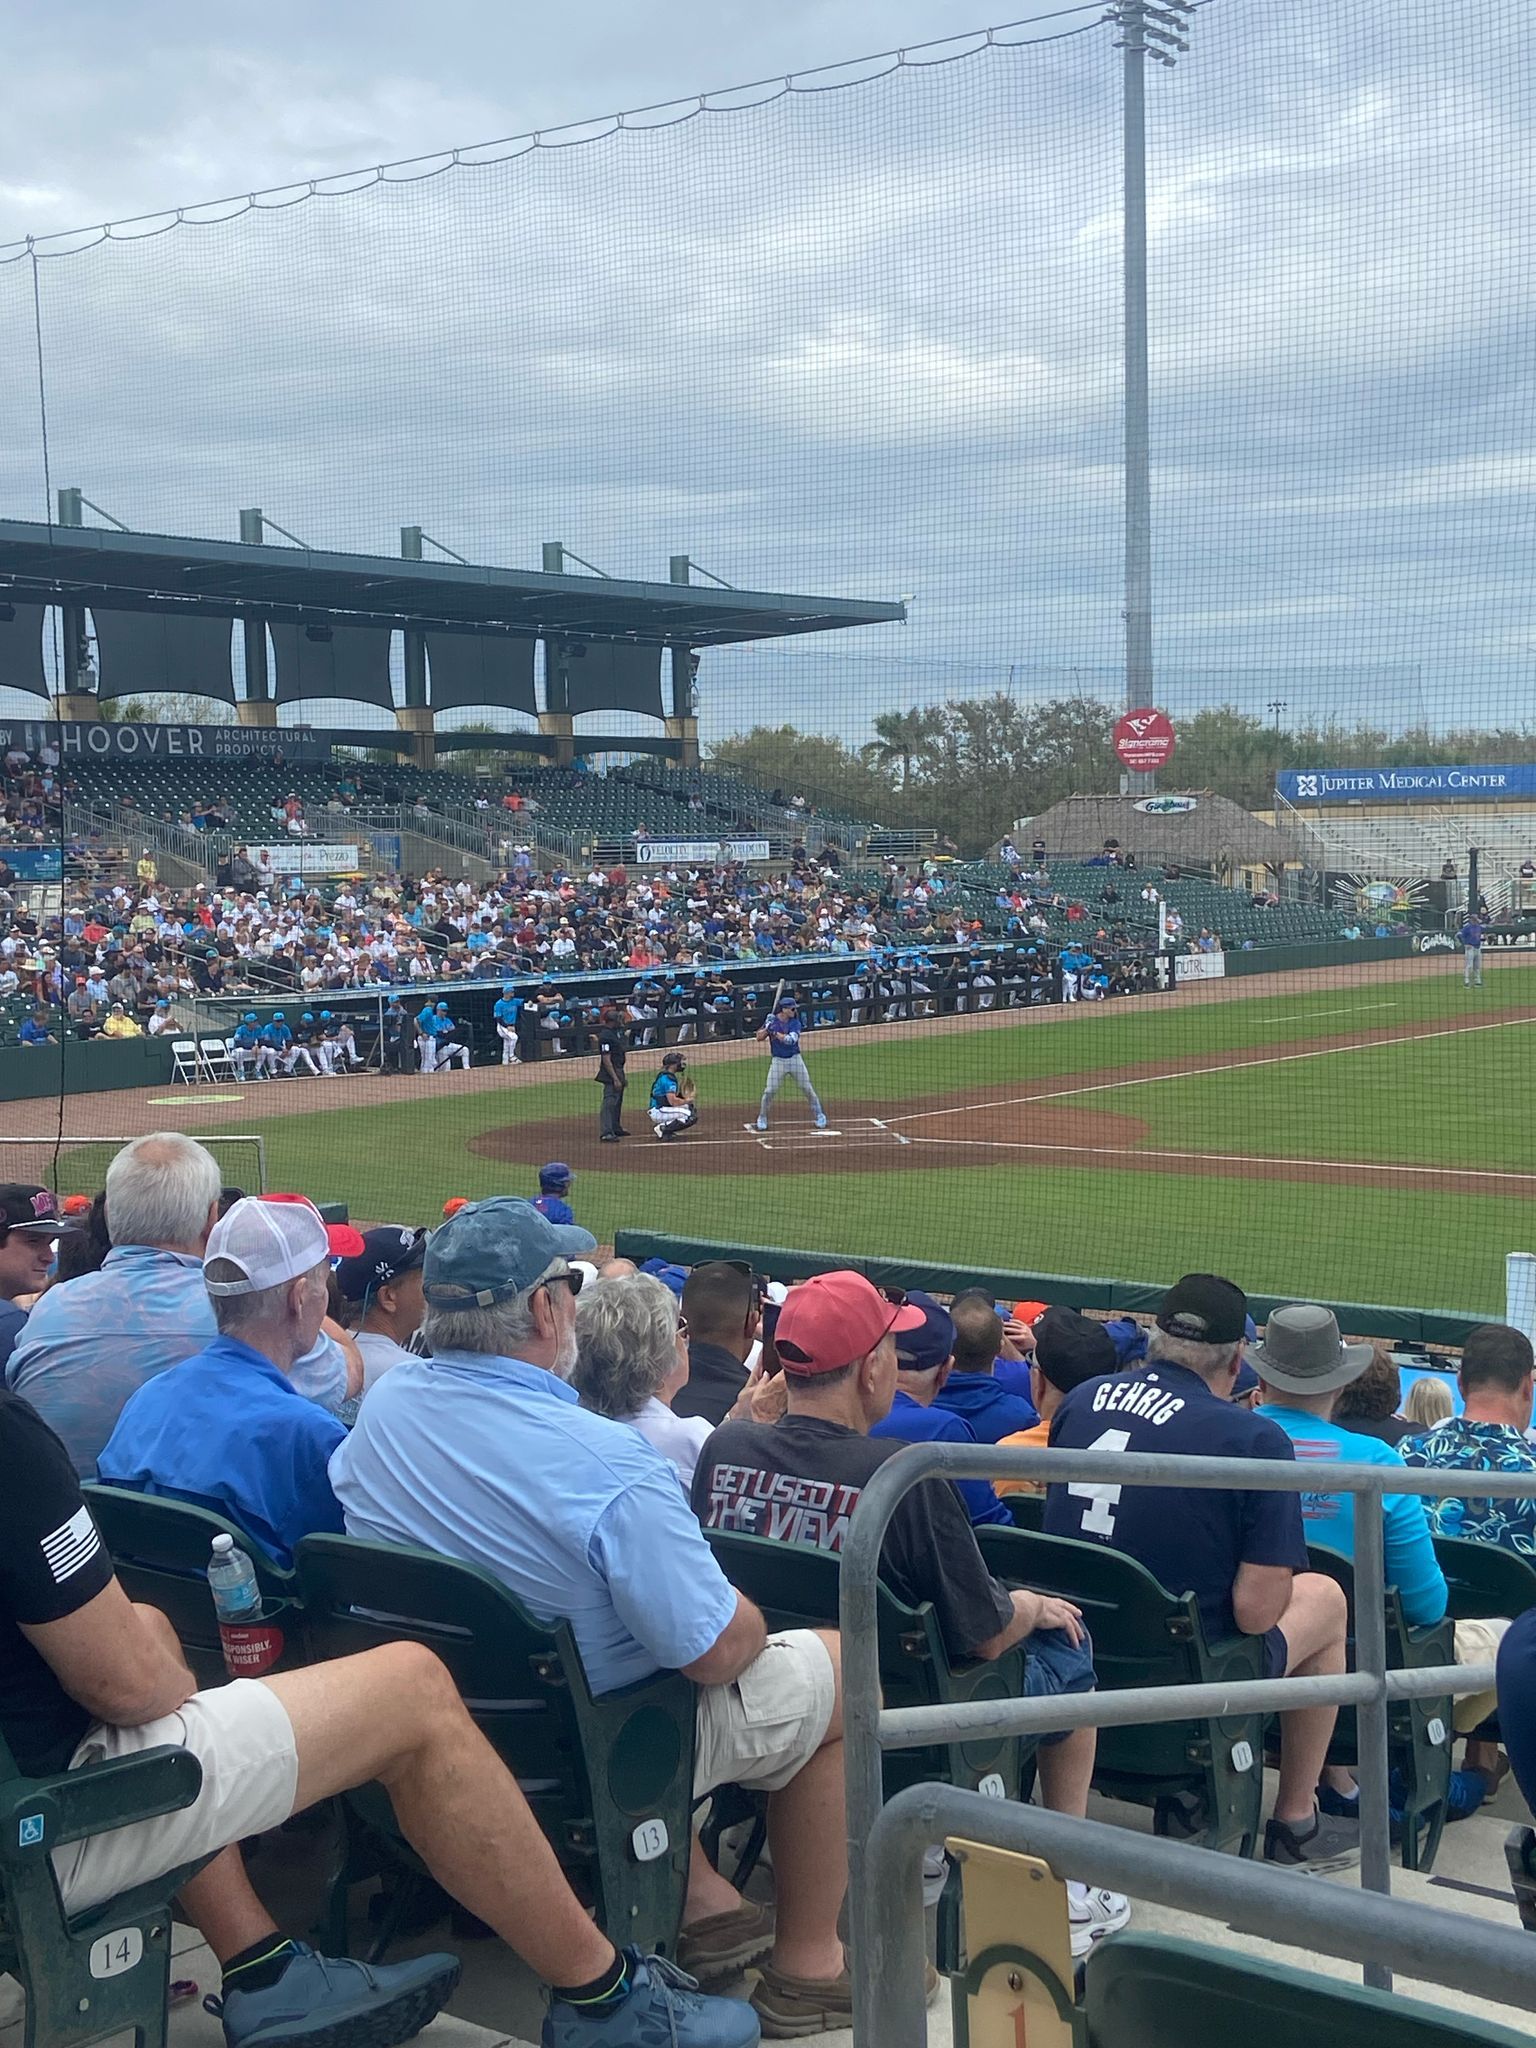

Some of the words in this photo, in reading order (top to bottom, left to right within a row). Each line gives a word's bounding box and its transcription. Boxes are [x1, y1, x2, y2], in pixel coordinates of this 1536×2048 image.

[62, 725, 204, 755] HOOVER
[215, 730, 316, 743] ARCHITECTURAL
[215, 743, 284, 755] PRODUCTS
[1320, 774, 1375, 796] JUPITER
[1379, 773, 1444, 789] MEDICAL
[1447, 772, 1508, 788] CENTER
[1092, 1381, 1186, 1426] GEHRIG
[711, 1463, 757, 1495] GET
[753, 1470, 835, 1511] USED
[1067, 1428, 1132, 1536] 4
[707, 1492, 766, 1533] THE
[767, 1502, 850, 1553] VIEW
[232, 1653, 260, 1665] WISER
[1236, 1746, 1249, 1767] 11
[641, 1826, 660, 1854] 13
[104, 1936, 131, 1970] 14
